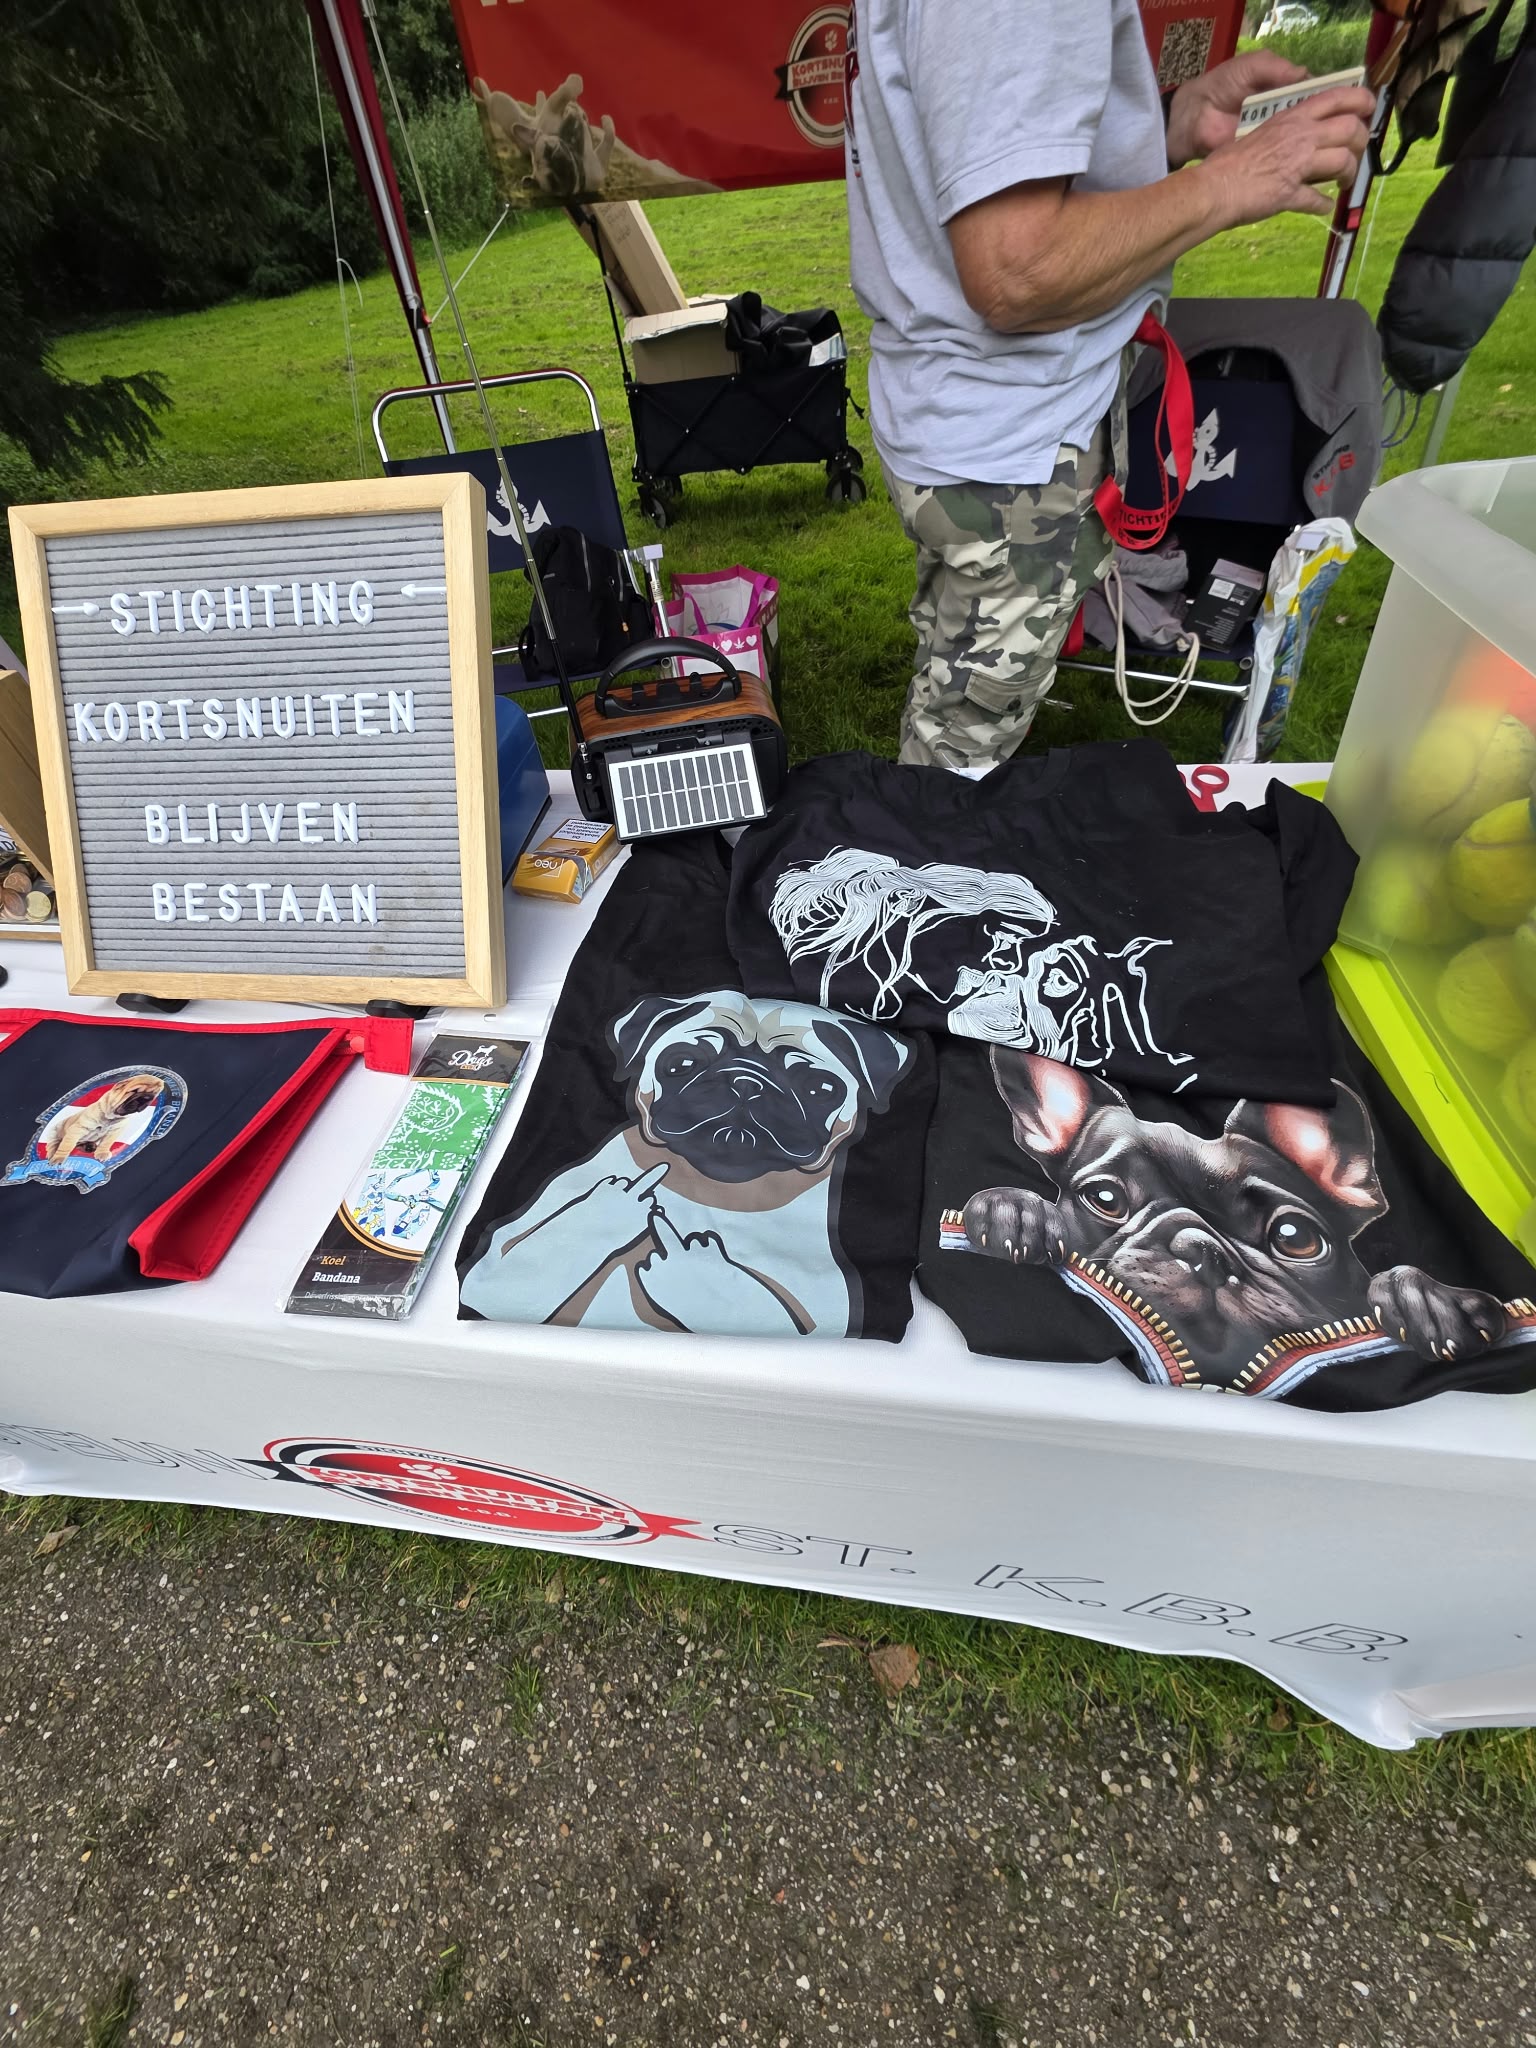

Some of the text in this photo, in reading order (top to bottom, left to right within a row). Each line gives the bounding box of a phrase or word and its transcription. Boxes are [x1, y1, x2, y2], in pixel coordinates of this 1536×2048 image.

[109, 579, 375, 636] STICHTING
[73, 689, 416, 744] KORTSNUITEN
[145, 801, 360, 846] BLIJVEN
[534, 859, 558, 870] neo
[152, 882, 379, 926] BESTAAN
[448, 1049, 493, 1071] Dogs
[312, 1271, 361, 1284] Bandana
[320, 1255, 347, 1266] Koel
[0, 1422, 268, 1481] TEUN
[295, 1465, 626, 1519] KORTSNUITEN
[713, 1524, 916, 1575] ST.
